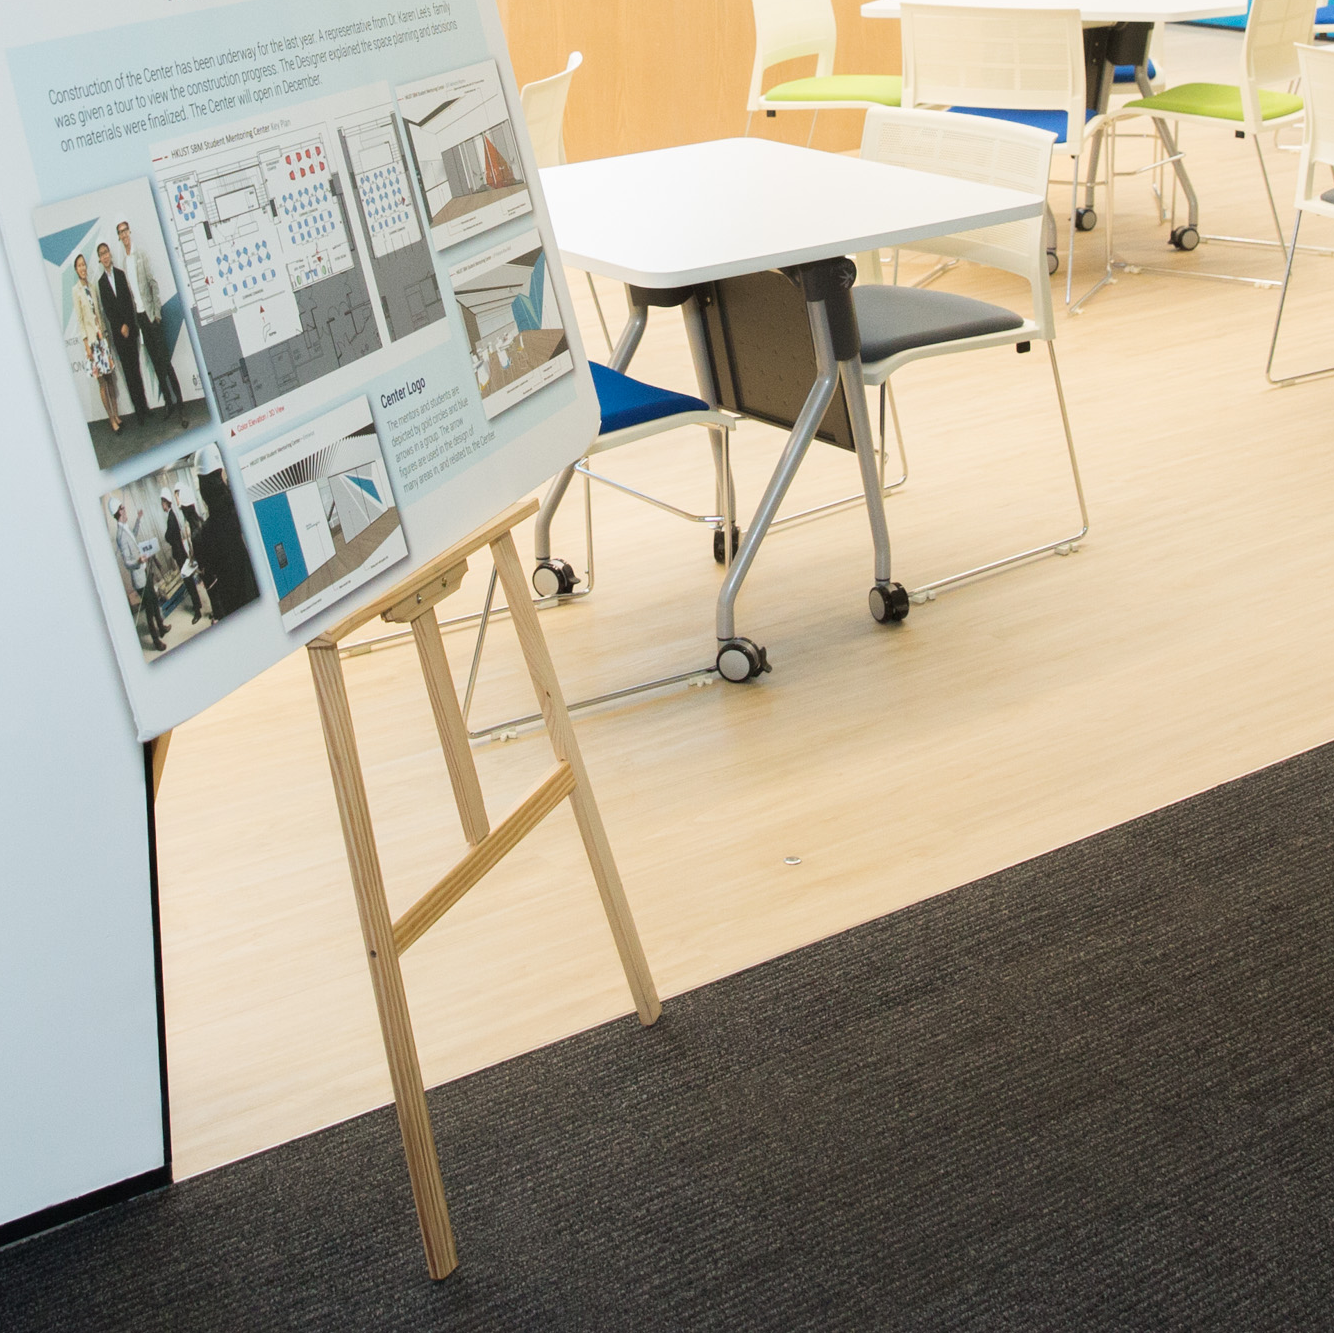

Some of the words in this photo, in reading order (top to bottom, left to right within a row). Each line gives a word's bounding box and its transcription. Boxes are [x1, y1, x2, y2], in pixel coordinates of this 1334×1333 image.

[48, 79, 113, 105] Construction
[115, 72, 125, 90] of
[126, 70, 142, 86] the
[143, 66, 173, 83] Center
[175, 61, 193, 76] has
[193, 55, 215, 72] been
[217, 46, 257, 66] underway
[257, 41, 268, 56] for
[270, 38, 283, 54] the
[284, 34, 299, 50] last
[299, 33, 317, 50] year.
[318, 29, 324, 42] A
[324, 18, 372, 43] representative
[372, 15, 388, 30] from
[388, 13, 397, 26] Dr.
[397, 9, 416, 24] Karen
[416, 6, 432, 20] Lee's
[432, 0, 451, 16] family
[54, 113, 76, 128] was
[78, 106, 105, 127] given
[106, 105, 113, 116] a
[114, 96, 134, 114] tour
[136, 93, 146, 109] to
[147, 90, 168, 107] view
[169, 85, 186, 101] the
[186, 72, 241, 96] construction
[241, 63, 279, 85] progress.
[279, 58, 295, 73] The
[295, 51, 328, 72] Designer
[328, 45, 361, 63] explained
[361, 39, 372, 53] the
[372, 36, 393, 53] space
[392, 29, 419, 48] planning
[419, 25, 430, 38] and
[431, 19, 458, 36] decisions
[60, 138, 75, 152] on
[76, 124, 122, 148] materials
[123, 120, 147, 136] were
[148, 107, 189, 130] finalized.
[189, 102, 207, 119] The
[207, 95, 236, 113] Center
[237, 88, 253, 106] will
[253, 86, 274, 104] open
[274, 80, 282, 96] in
[282, 73, 323, 95] December.
[171, 147, 189, 159] HKUST
[190, 143, 204, 154] SBM
[204, 137, 225, 150] Student
[225, 129, 253, 144] Mentoring
[253, 125, 270, 136] Center
[270, 122, 280, 133] Key
[280, 118, 291, 128] Plan
[381, 386, 406, 409] Center
[406, 377, 425, 395] Logo
[387, 419, 399, 432] The
[399, 408, 420, 424] mentors
[420, 400, 430, 414] and
[430, 390, 451, 406] students
[451, 386, 460, 397] are
[237, 422, 248, 433] Color
[248, 414, 266, 427] Elevation
[275, 405, 285, 414] View
[391, 427, 414, 447] depicted
[414, 423, 421, 436] by
[421, 418, 432, 433] gold
[432, 409, 448, 426] circles
[448, 402, 458, 415] and
[458, 396, 468, 409] blue
[395, 445, 414, 463] arrows
[439, 424, 450, 436] The
[450, 417, 464, 432] arrow
[398, 460, 417, 480] figures
[418, 455, 427, 467] are
[427, 447, 439, 462] used
[444, 438, 453, 451] the
[453, 429, 470, 447] design
[403, 478, 419, 493] many
[419, 470, 433, 485] areas
[440, 459, 449, 472] and
[449, 448, 466, 464] related
[471, 439, 481, 452] the
